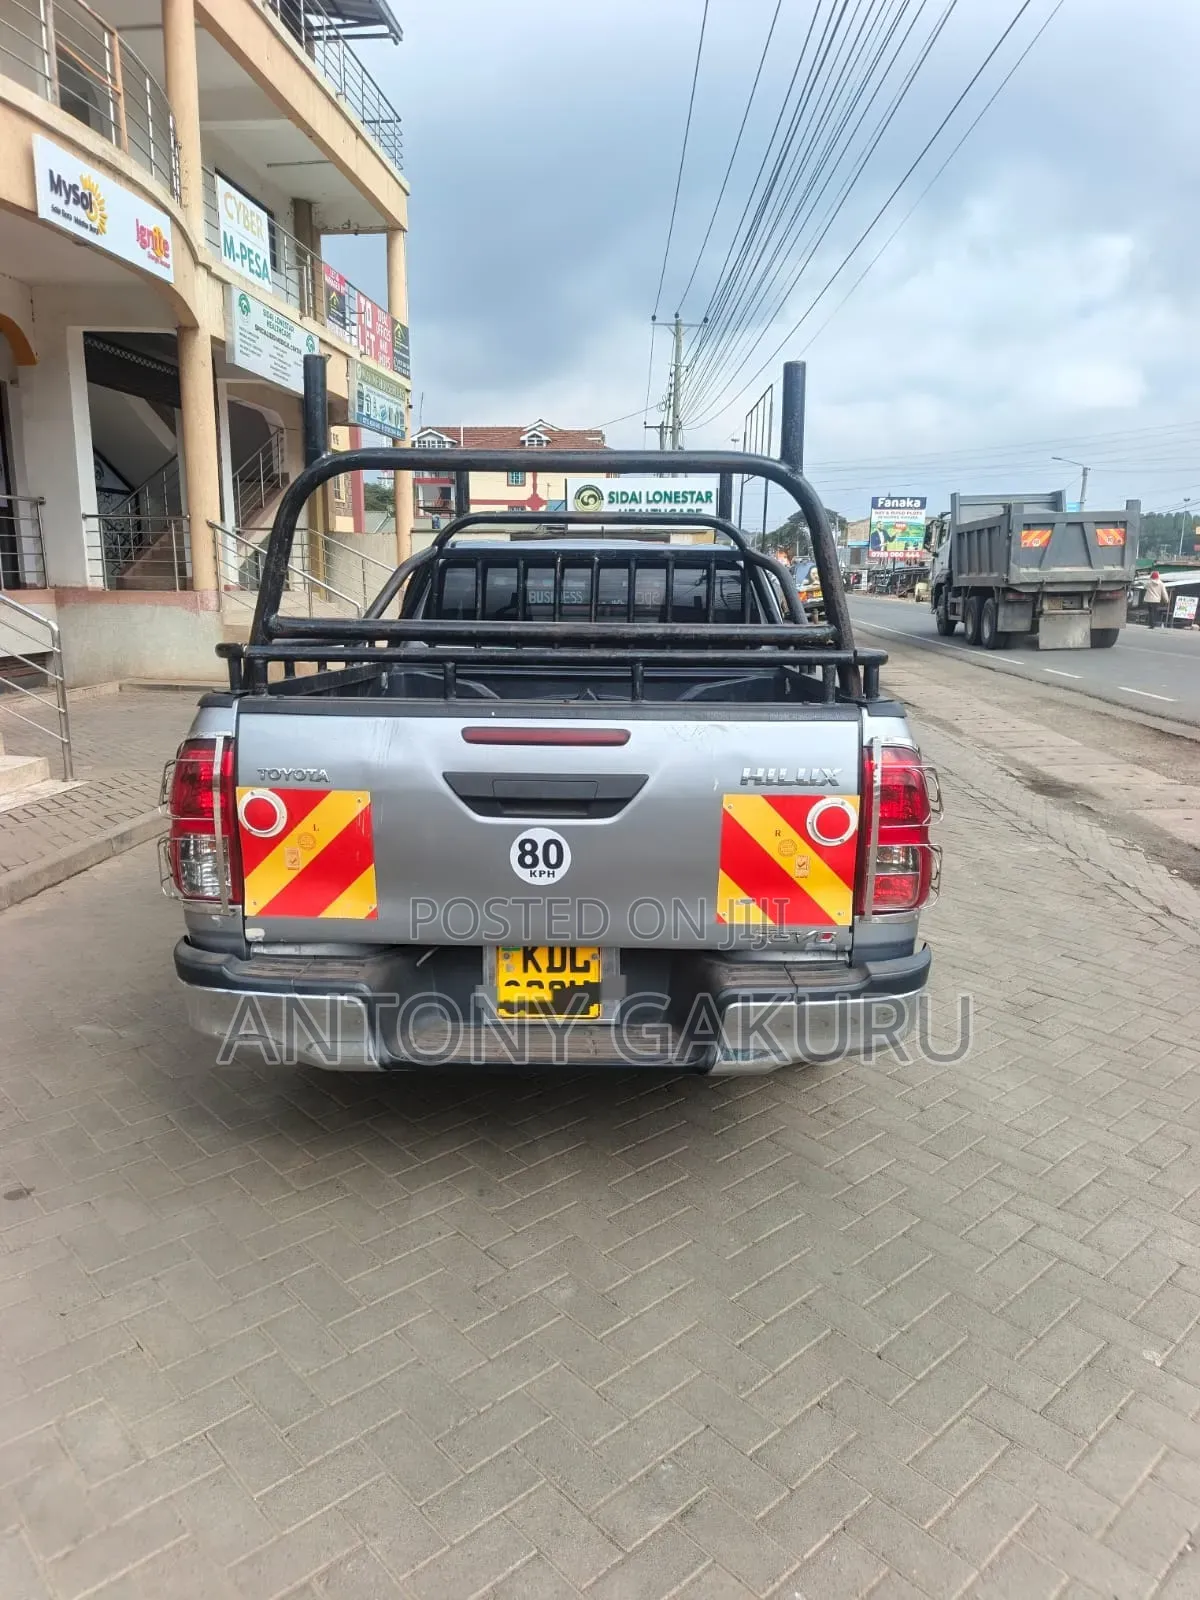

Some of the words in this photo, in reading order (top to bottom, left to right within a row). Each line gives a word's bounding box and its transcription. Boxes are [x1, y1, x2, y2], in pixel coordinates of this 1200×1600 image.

[49, 168, 93, 214] MySol
[223, 191, 265, 242] CYBER
[135, 217, 170, 259] Ignite
[223, 230, 272, 285] M-PESA
[360, 294, 372, 329] TO
[359, 324, 375, 360] LET
[607, 490, 643, 504] SIDAI
[646, 490, 713, 504] LONESTAR
[878, 497, 921, 508] Fanaka
[528, 591, 584, 604] BUSIESS
[257, 767, 331, 784] TOYOTA
[740, 767, 843, 787] HILUX
[516, 838, 565, 870] 80
[529, 869, 556, 879] KPH
